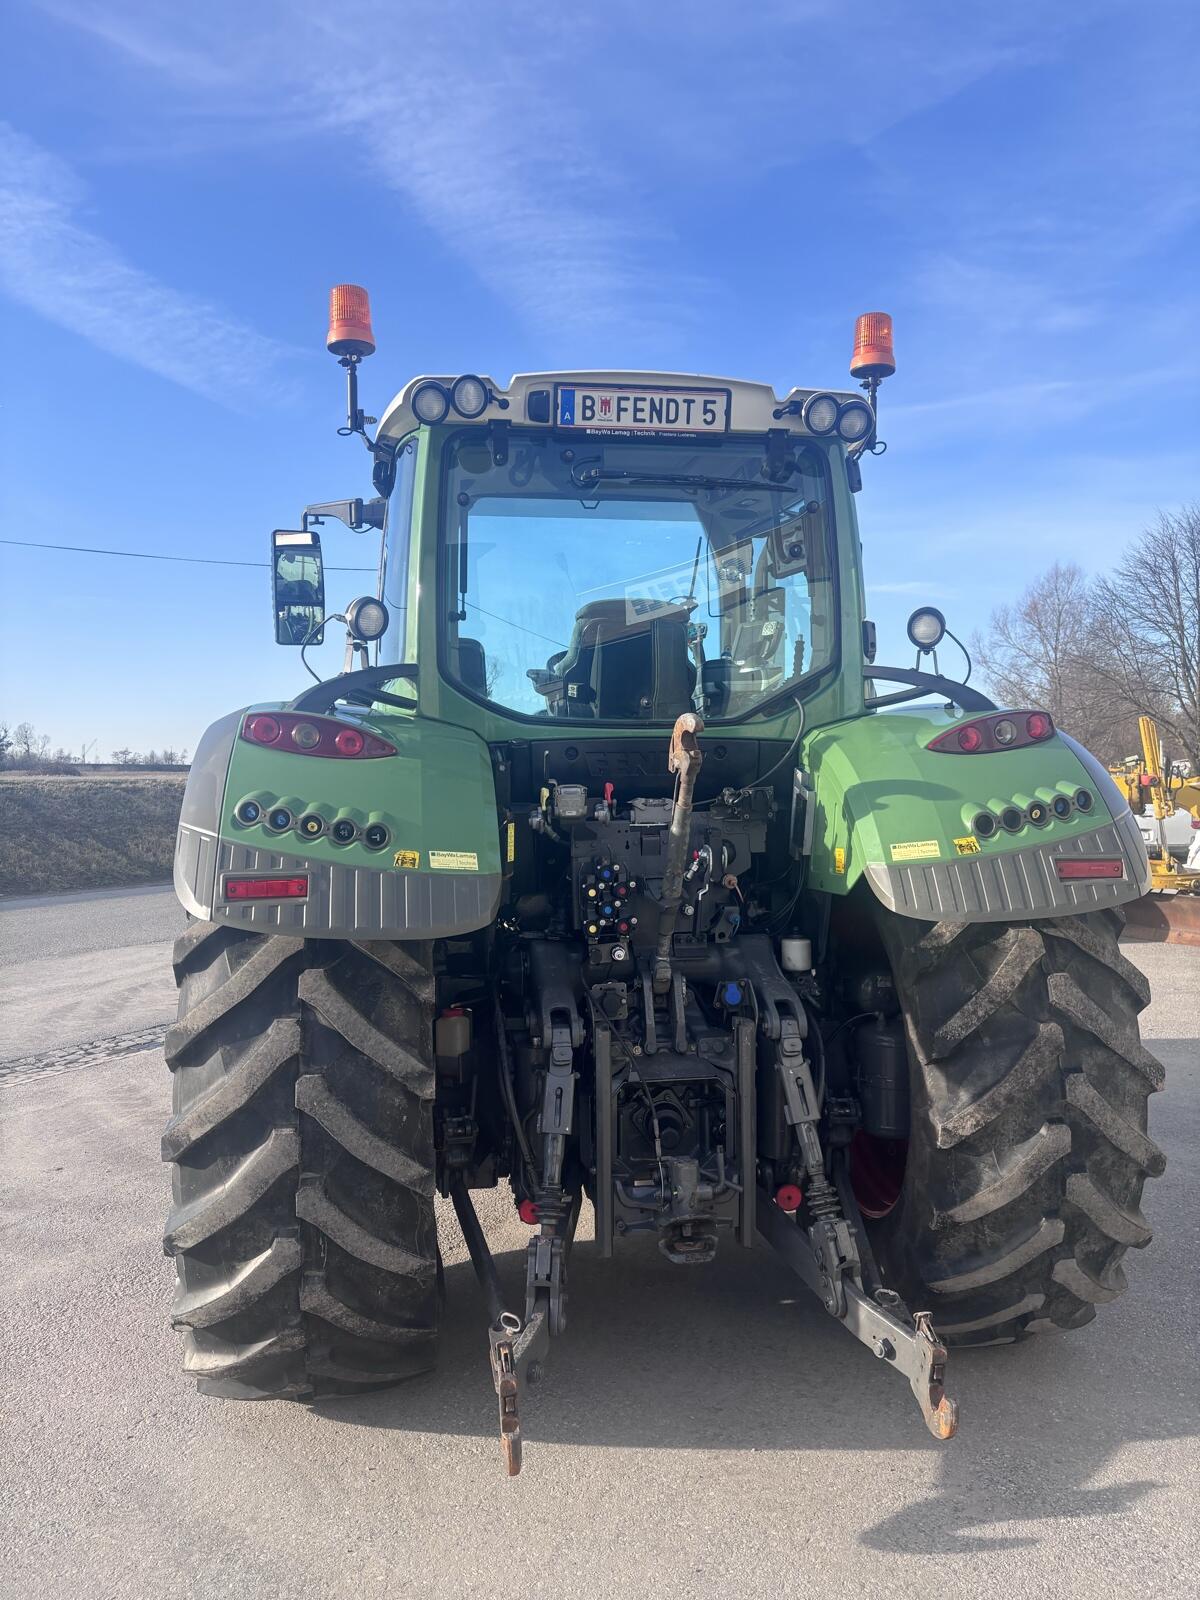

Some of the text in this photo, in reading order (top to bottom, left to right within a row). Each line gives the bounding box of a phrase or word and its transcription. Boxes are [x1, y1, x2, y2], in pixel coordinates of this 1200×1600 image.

[564, 412, 571, 420] A
[616, 396, 696, 425] FENDT
[702, 399, 717, 426] 5
